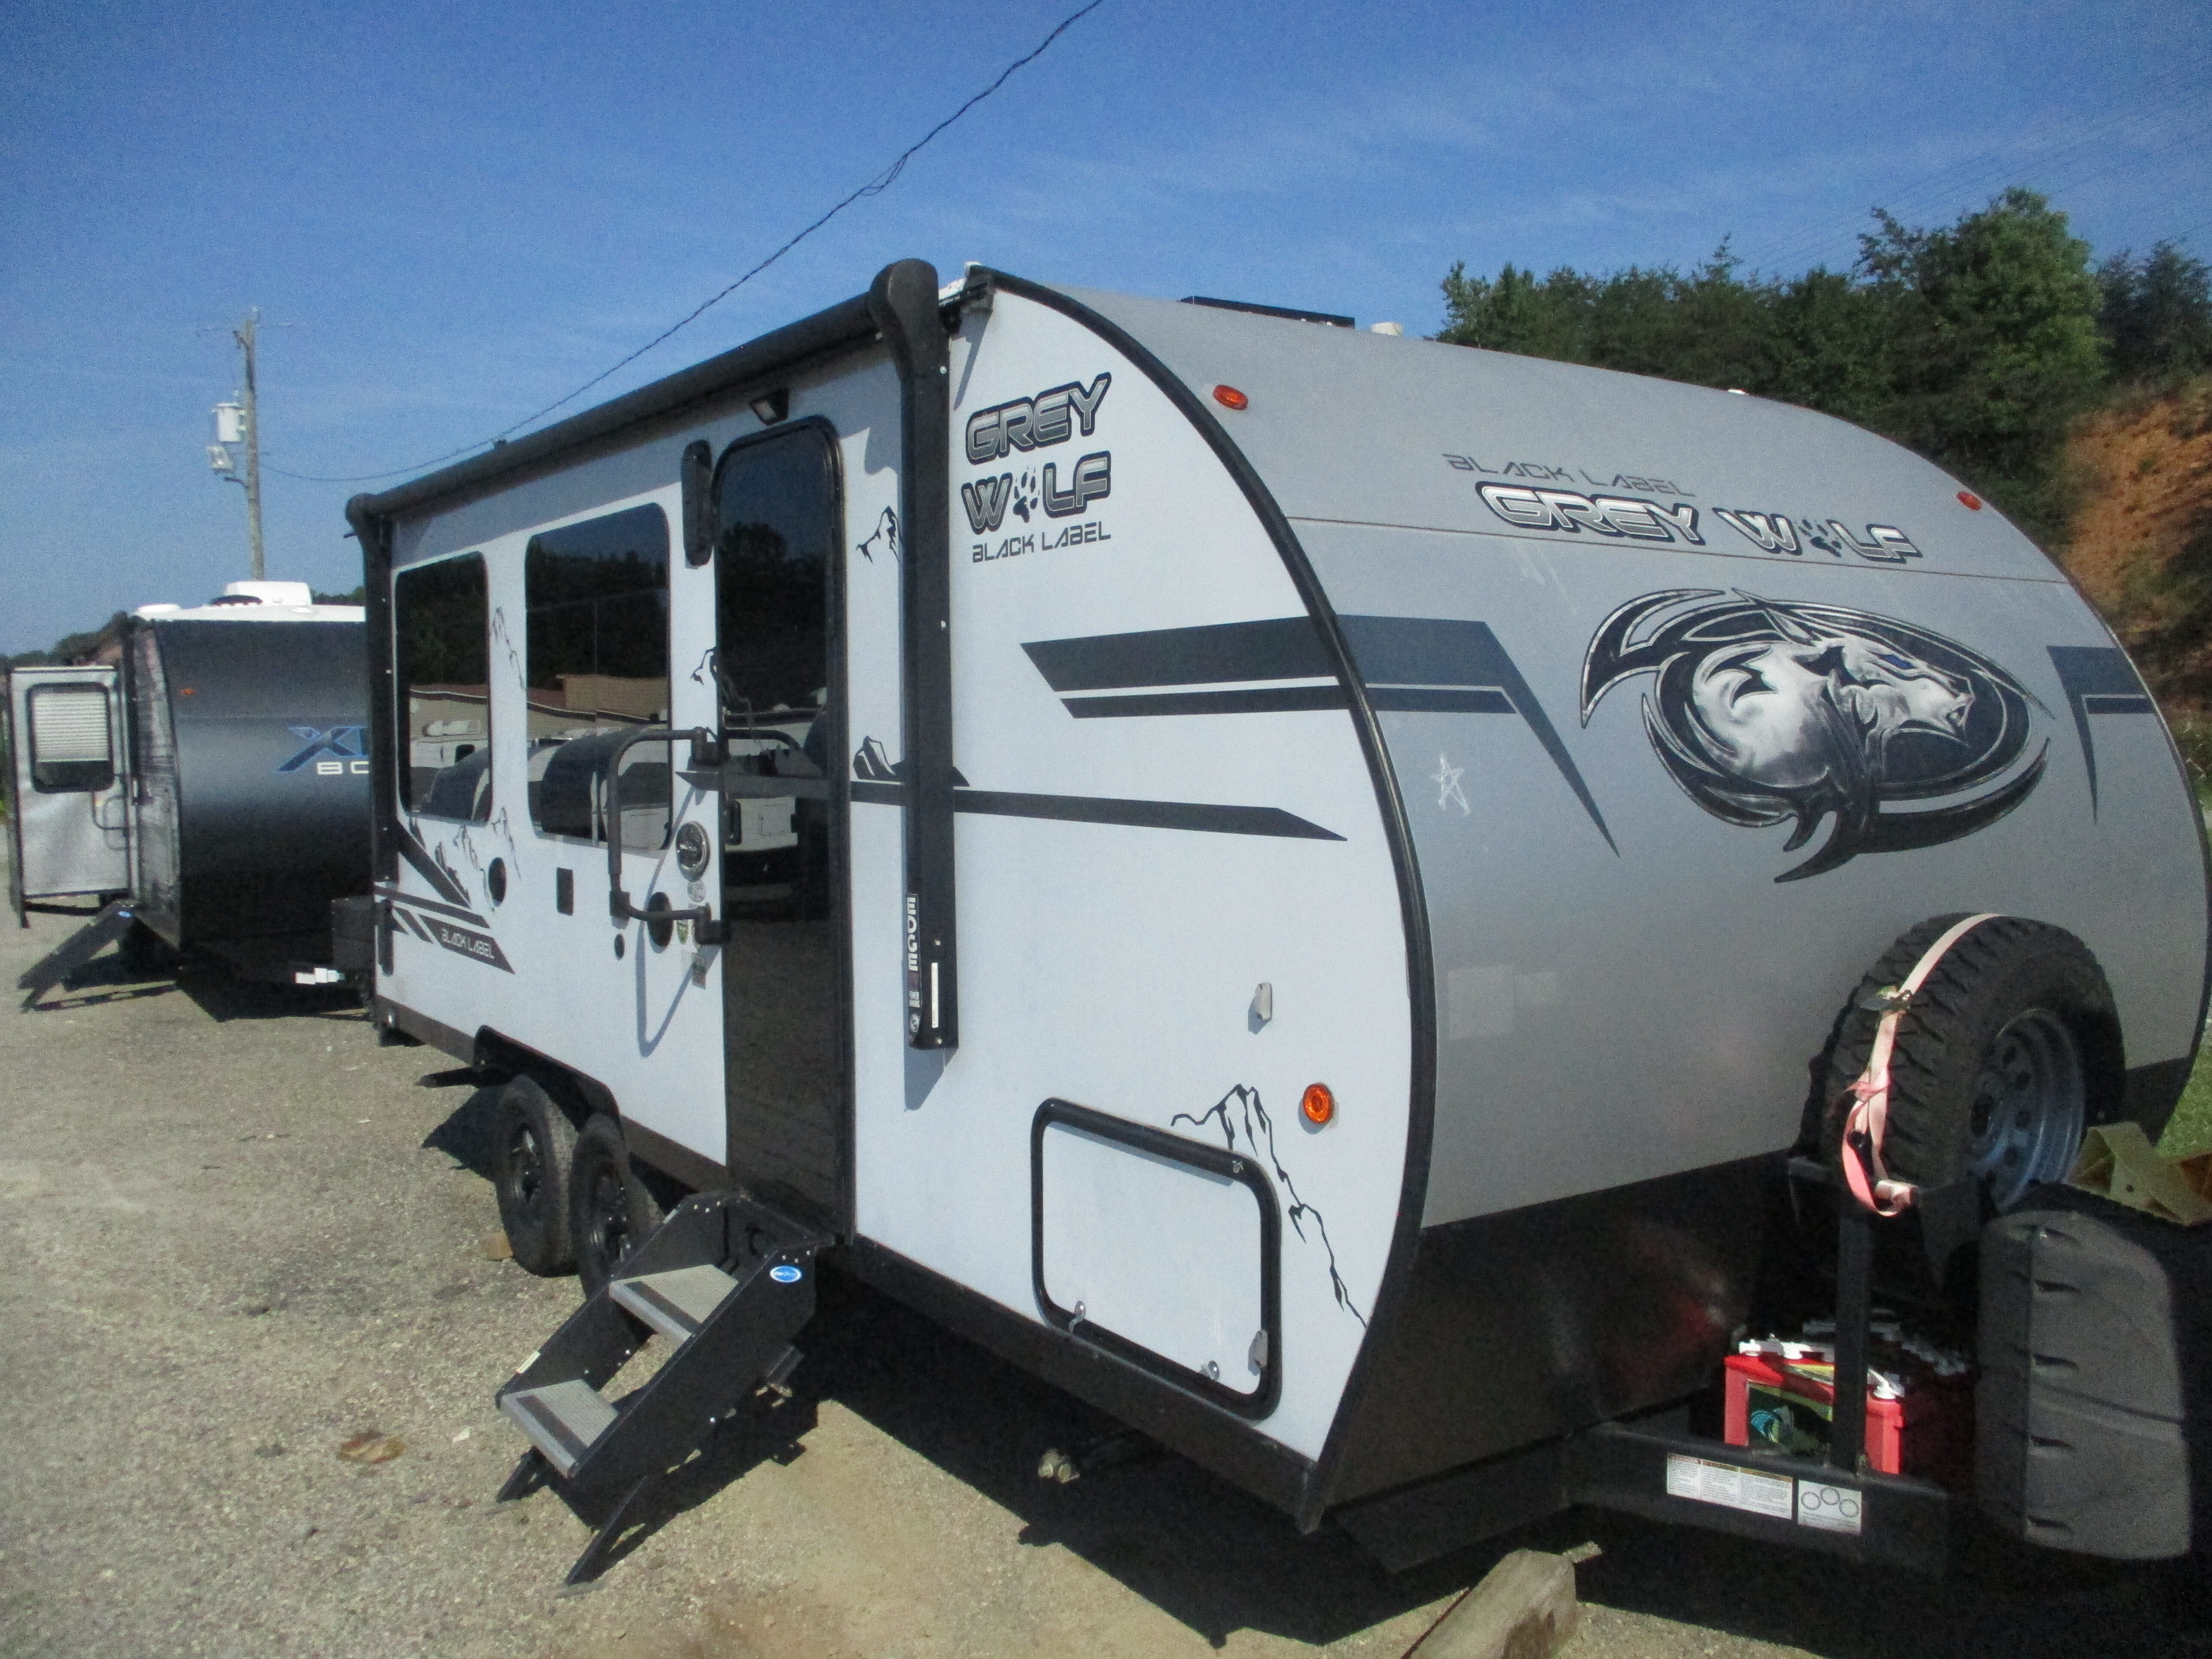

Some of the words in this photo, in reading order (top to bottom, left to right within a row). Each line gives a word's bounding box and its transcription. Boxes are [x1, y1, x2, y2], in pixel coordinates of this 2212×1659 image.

[965, 372, 1112, 465] GREY
[1442, 453, 1575, 483] BLACK
[1579, 469, 1695, 497] LABEL
[1475, 480, 1705, 547] GREY
[972, 534, 1034, 563] BLACK
[1042, 521, 1111, 551] LABEL
